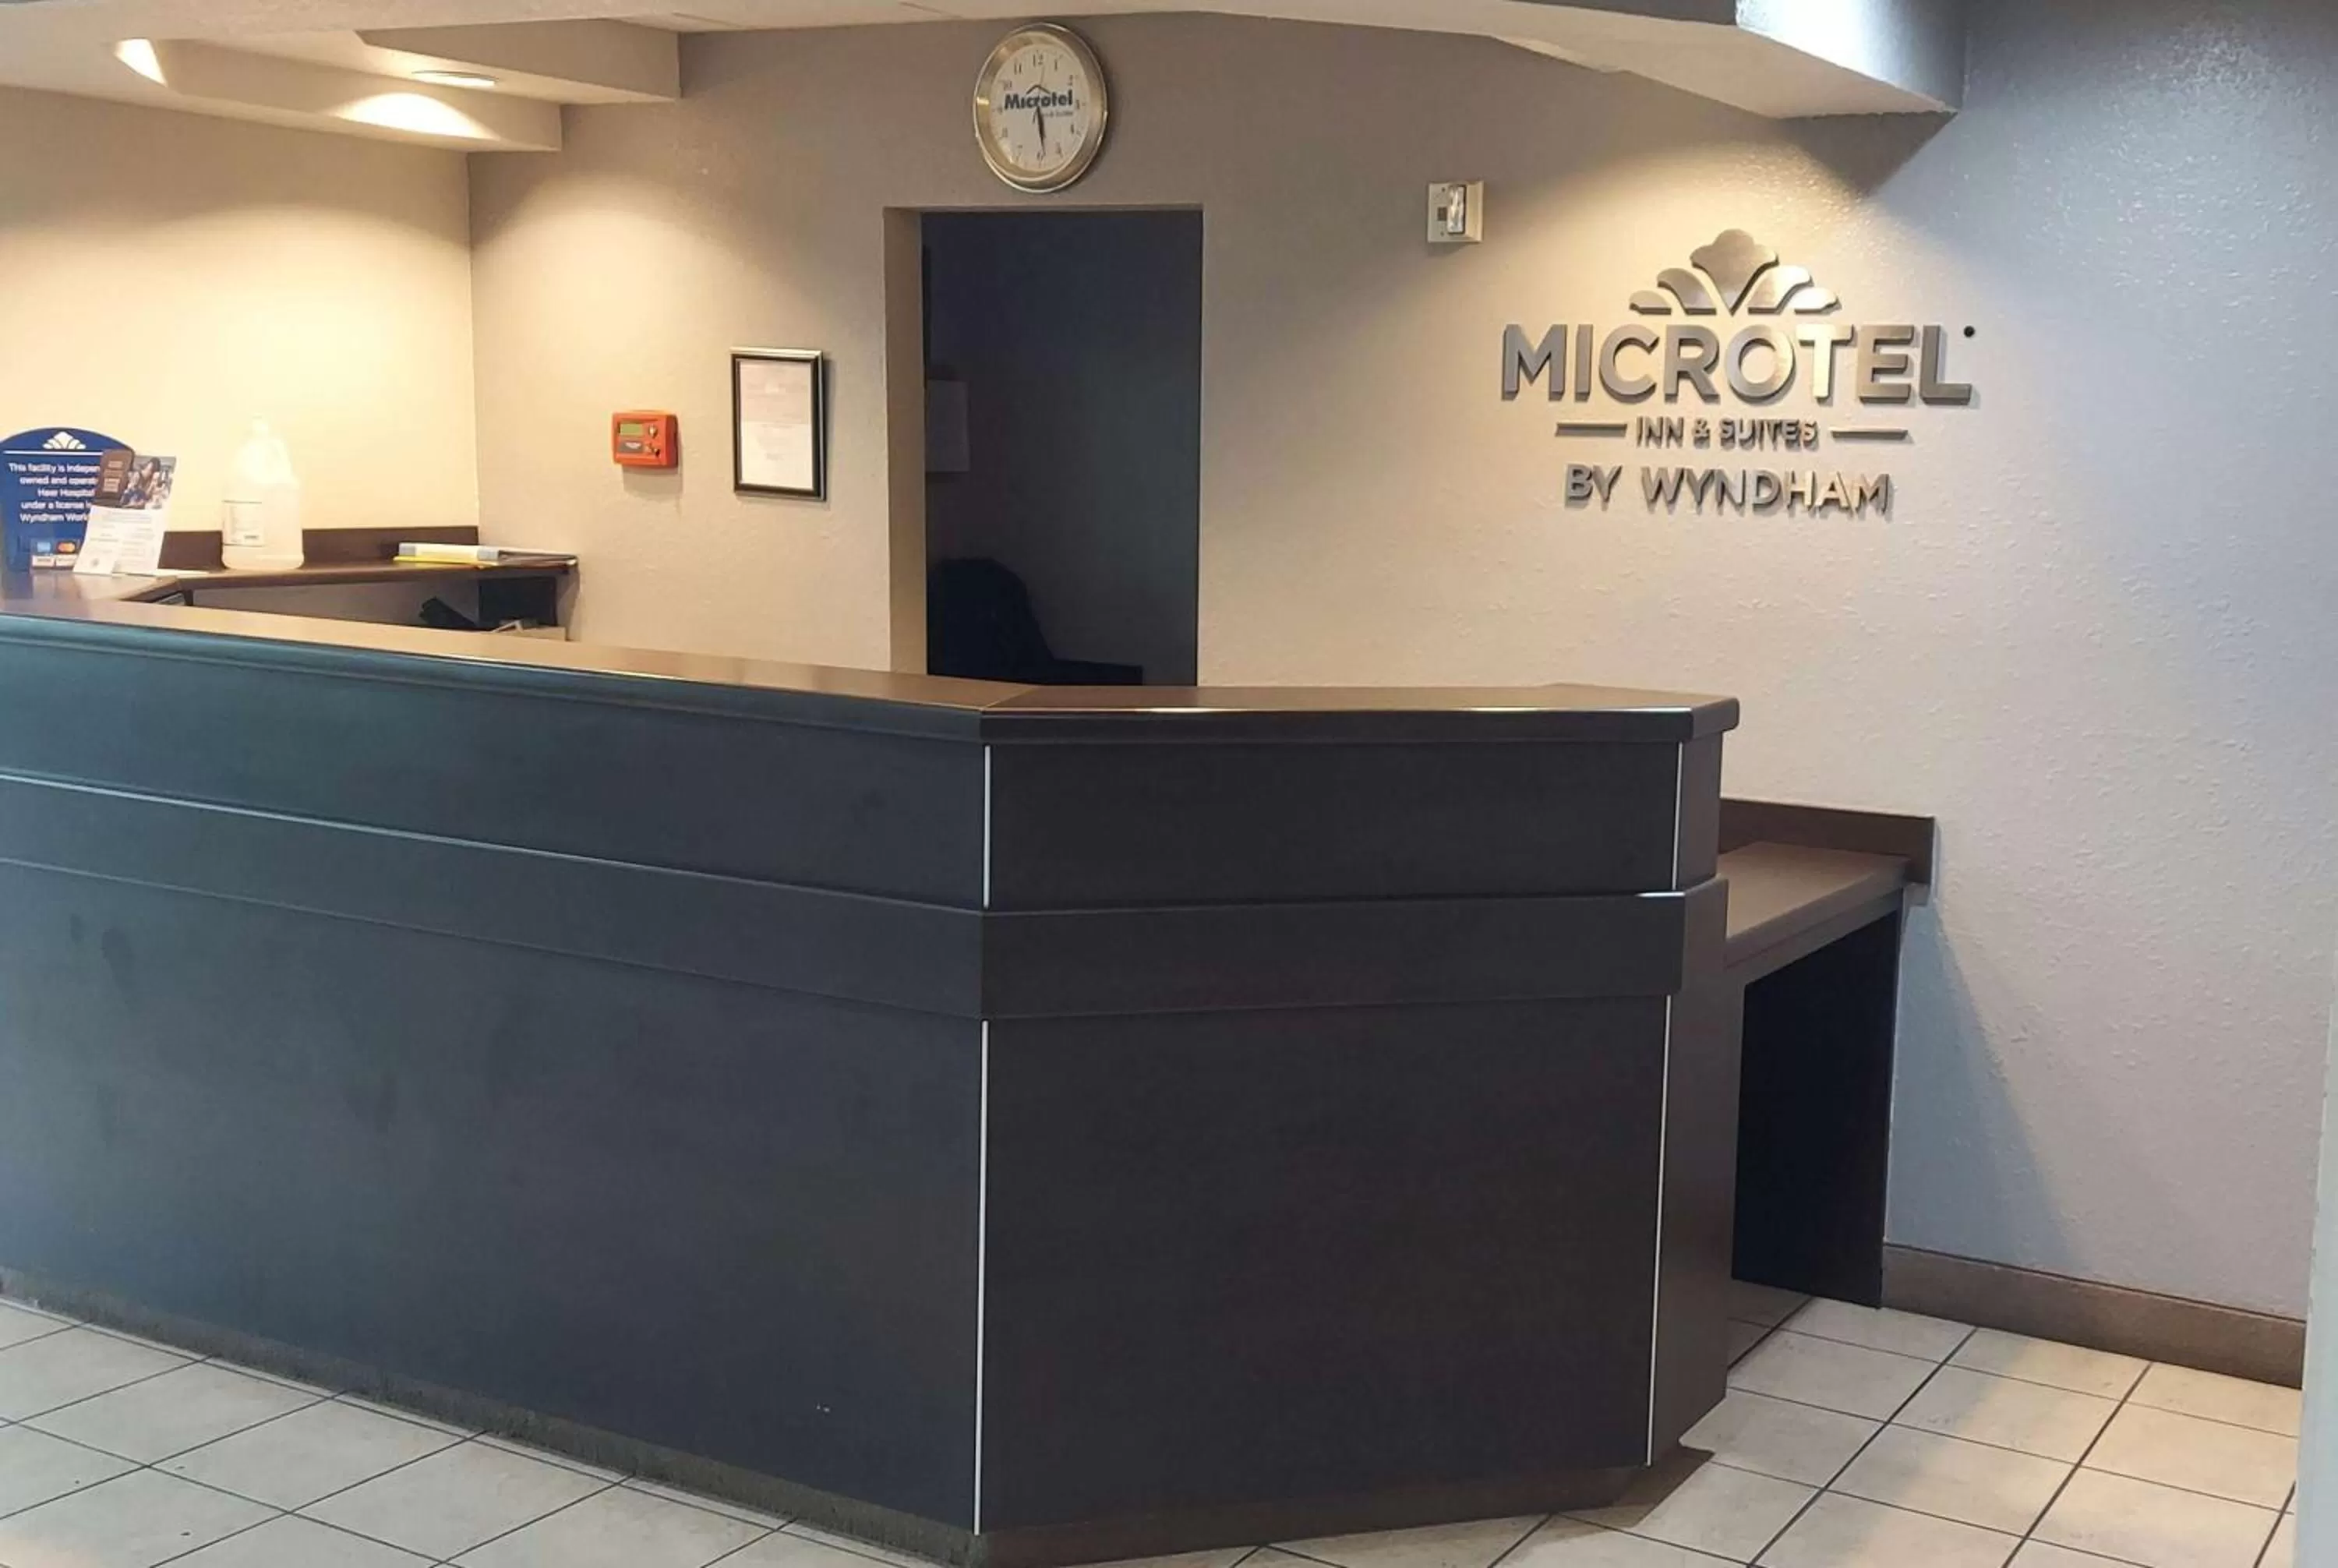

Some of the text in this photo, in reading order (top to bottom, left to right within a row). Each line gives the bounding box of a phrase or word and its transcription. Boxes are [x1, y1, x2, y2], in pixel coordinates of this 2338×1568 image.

[1004, 89, 1073, 110] Microtel
[1502, 323, 1974, 404] MICROTEL
[1637, 416, 1818, 448] INN & SUITES
[9, 463, 26, 472] This
[27, 463, 57, 474] facility
[58, 464, 65, 472] is
[19, 475, 49, 485] owned
[51, 475, 68, 485] and
[1565, 464, 1892, 515] BY WYNDHAM
[21, 500, 46, 509] under
[20, 514, 64, 524] Wyndham
